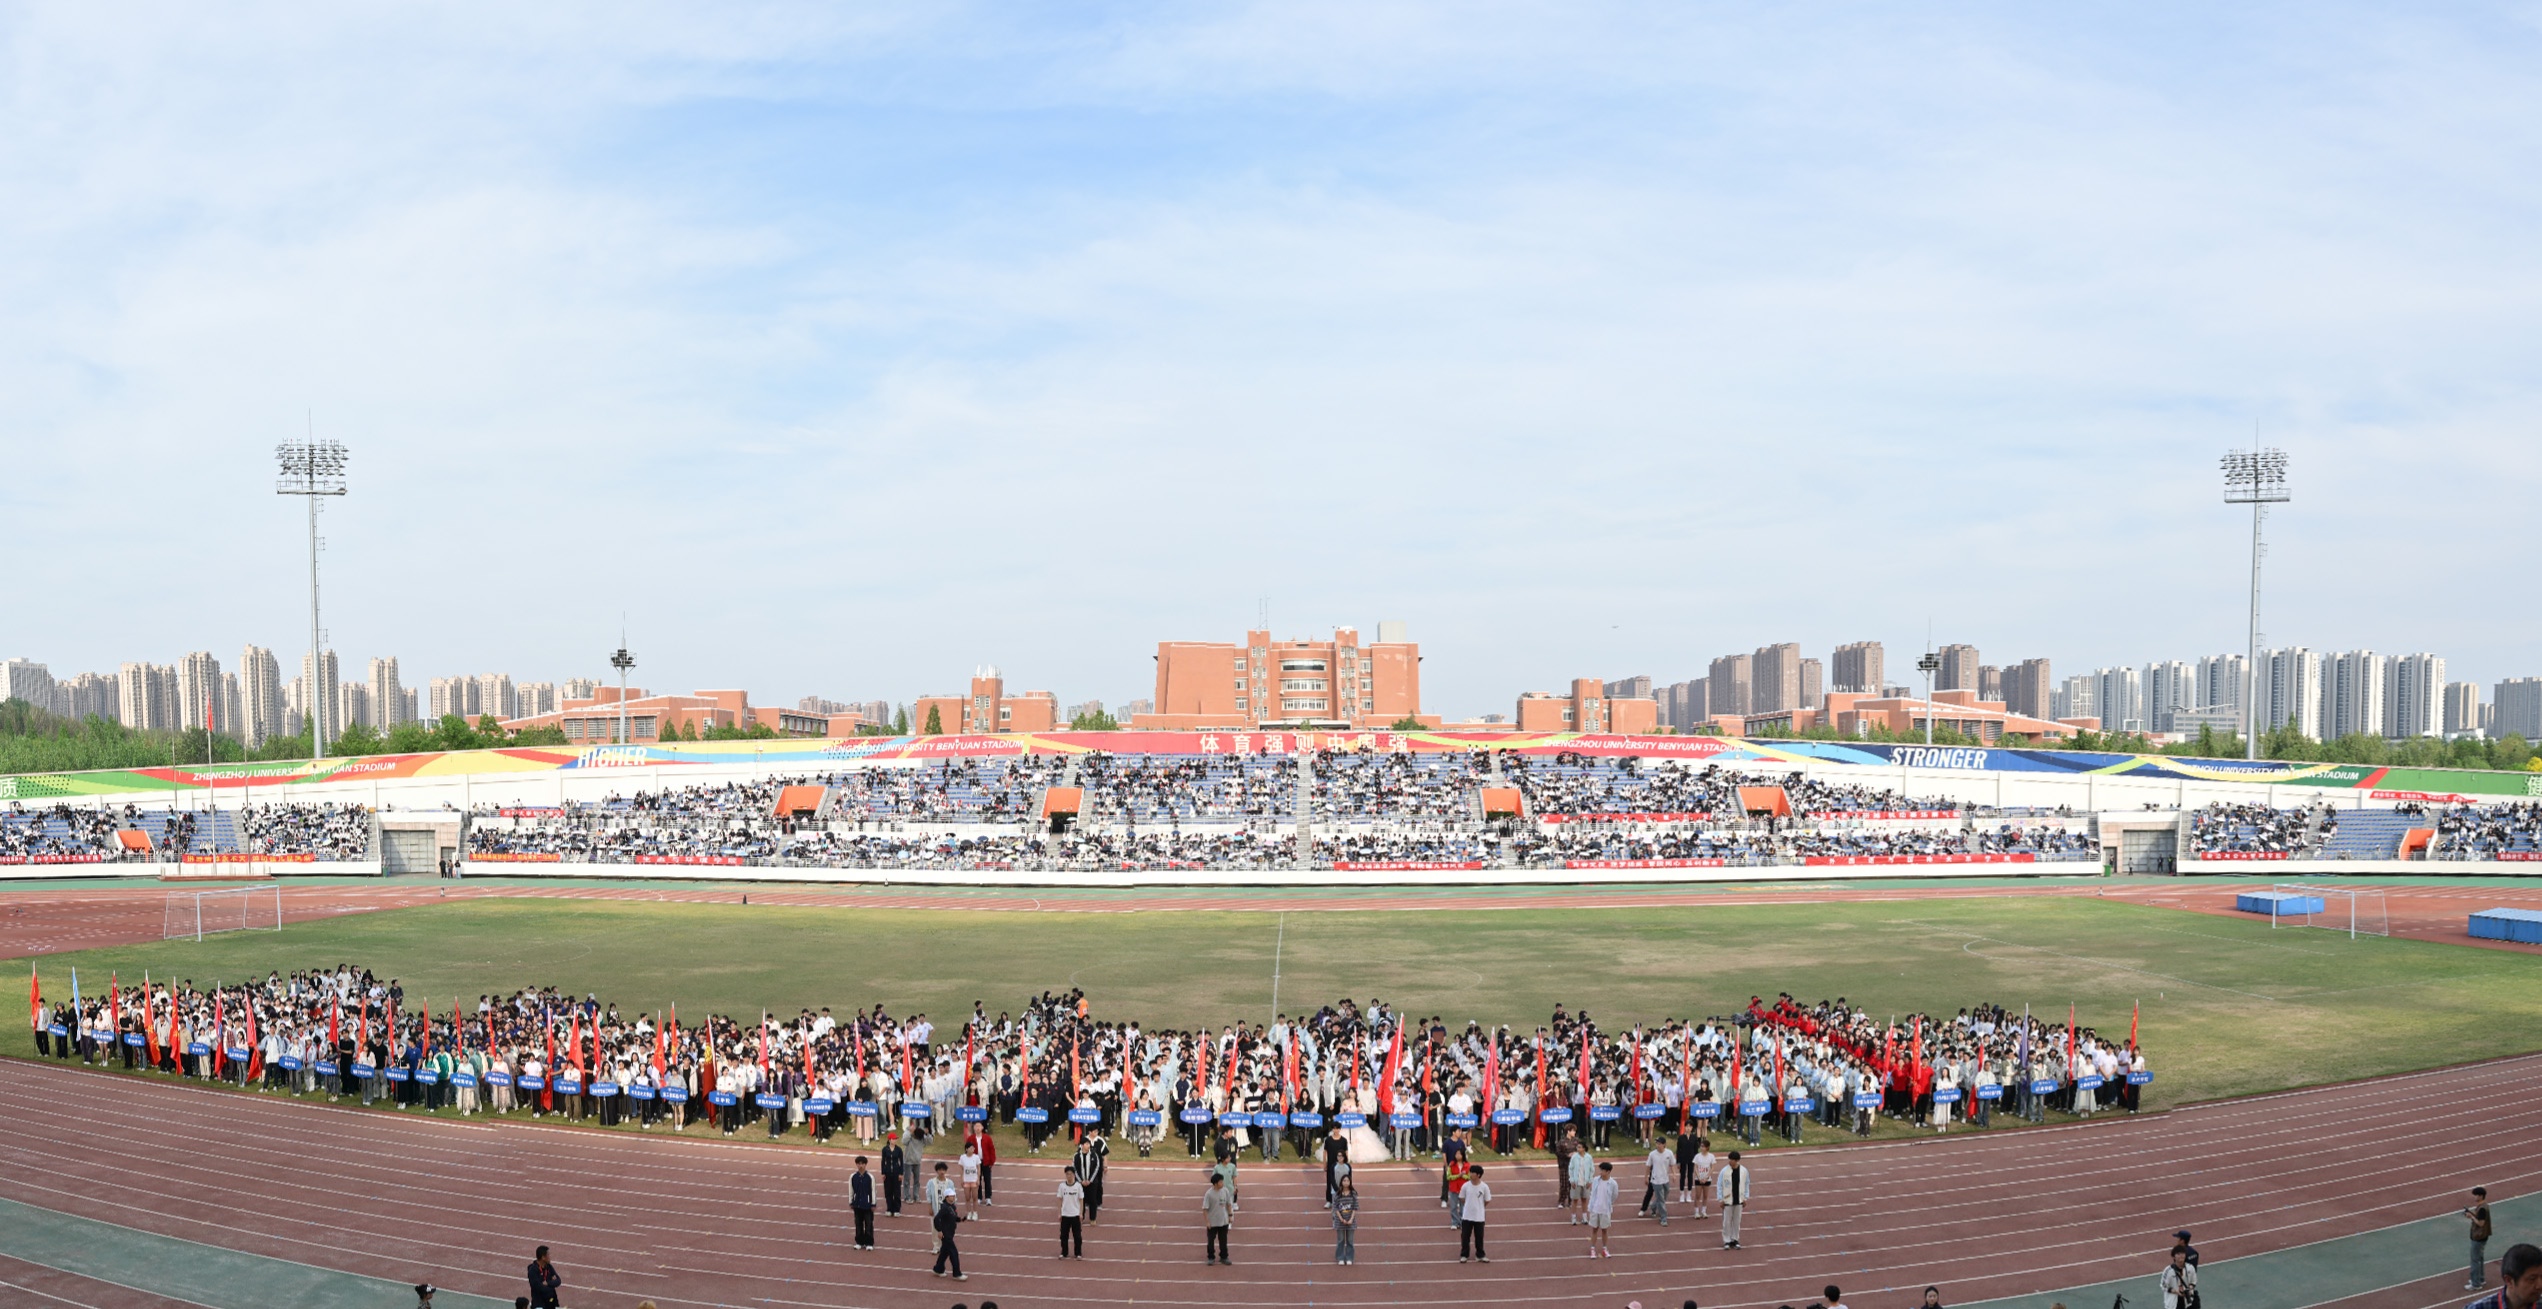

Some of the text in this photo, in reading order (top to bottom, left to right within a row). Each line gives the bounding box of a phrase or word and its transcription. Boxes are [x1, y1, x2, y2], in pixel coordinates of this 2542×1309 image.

[881, 742, 935, 753] UNIVERSITY
[936, 741, 980, 751] BENYUAN
[981, 739, 1025, 749] STADIUM
[1199, 733, 1408, 753] 体育强则中国强
[1602, 740, 1657, 750] UNIVERSITY
[1657, 742, 1702, 751] BENYUAN
[577, 747, 647, 768] HIGHER
[1891, 747, 1988, 769] STRONGER
[353, 762, 396, 772] STADIUM
[2316, 771, 2360, 780] STADIUM
